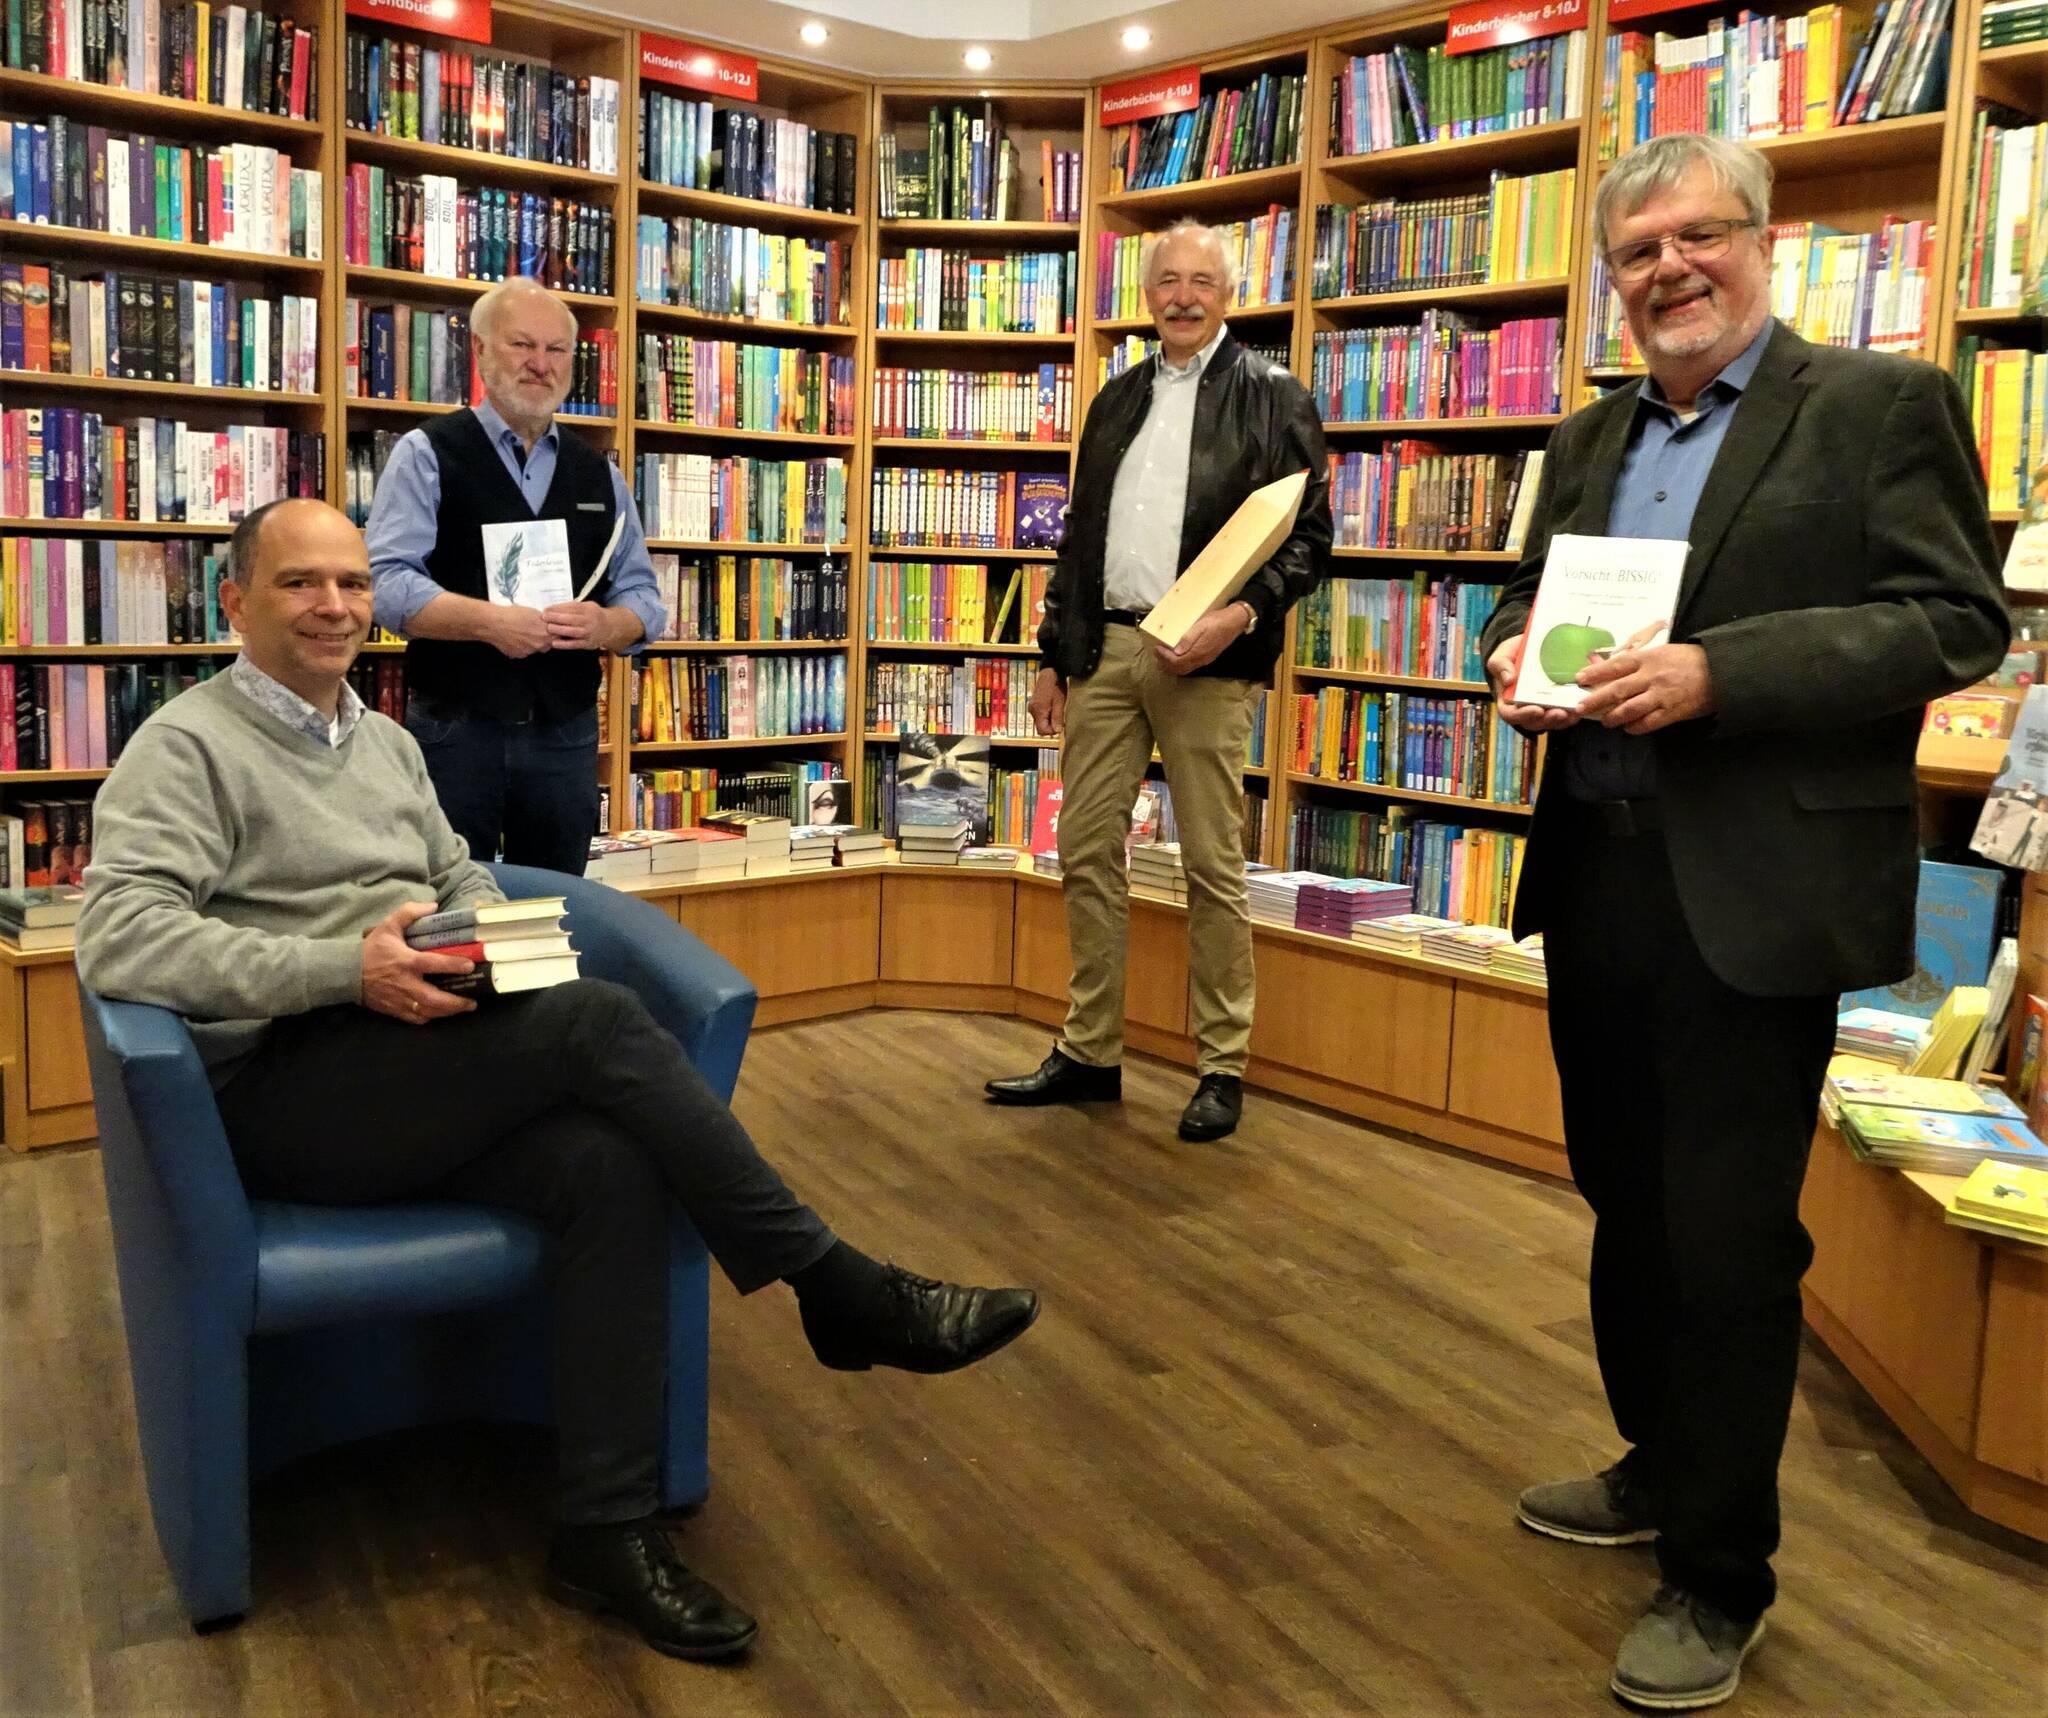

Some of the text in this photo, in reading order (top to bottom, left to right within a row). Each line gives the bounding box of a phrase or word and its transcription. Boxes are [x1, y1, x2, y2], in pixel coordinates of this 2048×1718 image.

[1542, 1, 1580, 18] 8-10J
[718, 69, 752, 87] 10-12J
[1103, 83, 1193, 112] Kinderbücher 8-10J
[240, 161, 252, 214] VORTEX
[262, 162, 274, 216] VORTEX
[425, 197, 434, 222] SOUL
[443, 200, 451, 224] SOUL
